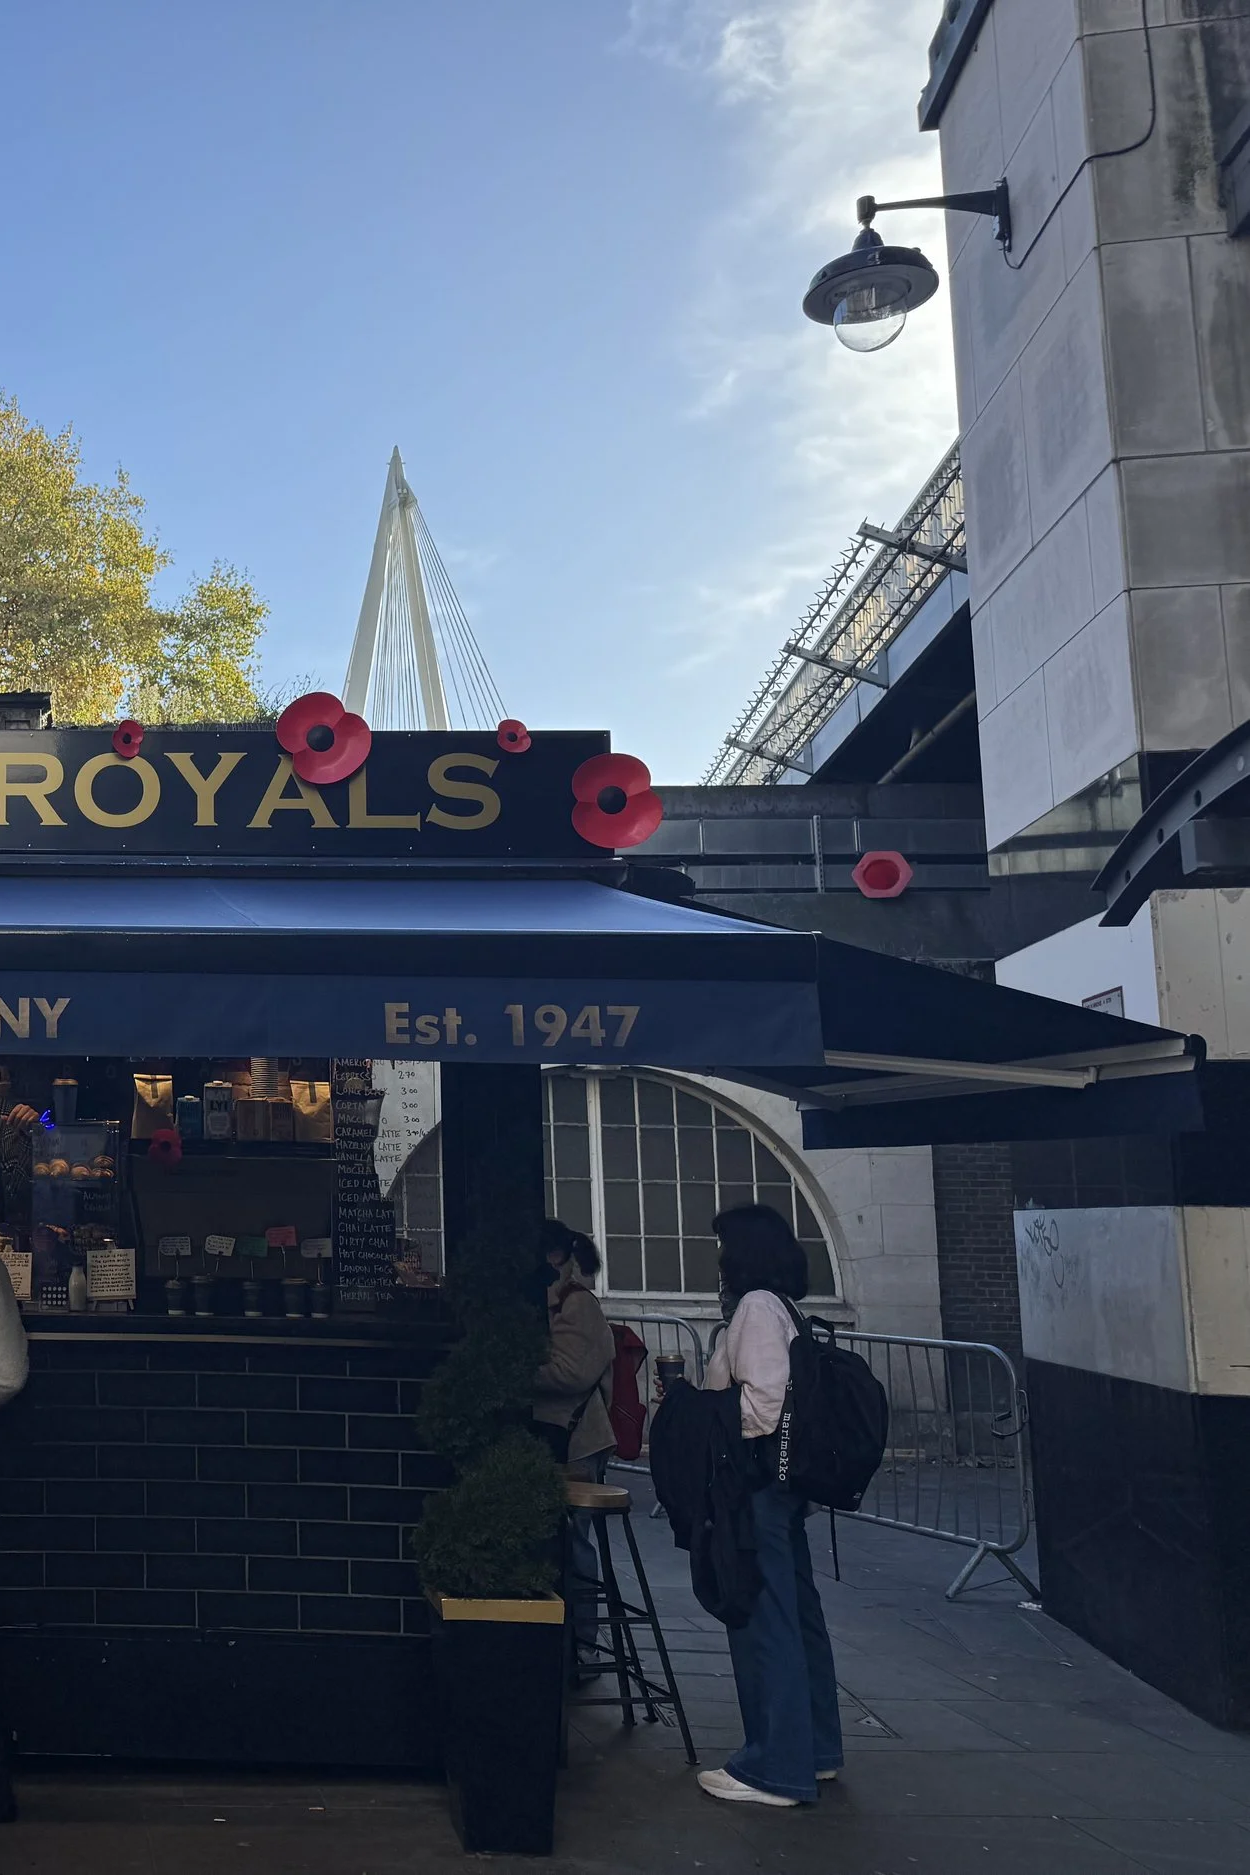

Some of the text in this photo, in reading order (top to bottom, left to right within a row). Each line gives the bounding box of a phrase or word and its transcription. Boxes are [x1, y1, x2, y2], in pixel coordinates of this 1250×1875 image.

[384, 1002, 641, 1047] Est. 1947
[779, 1412, 792, 1481] marimekko
